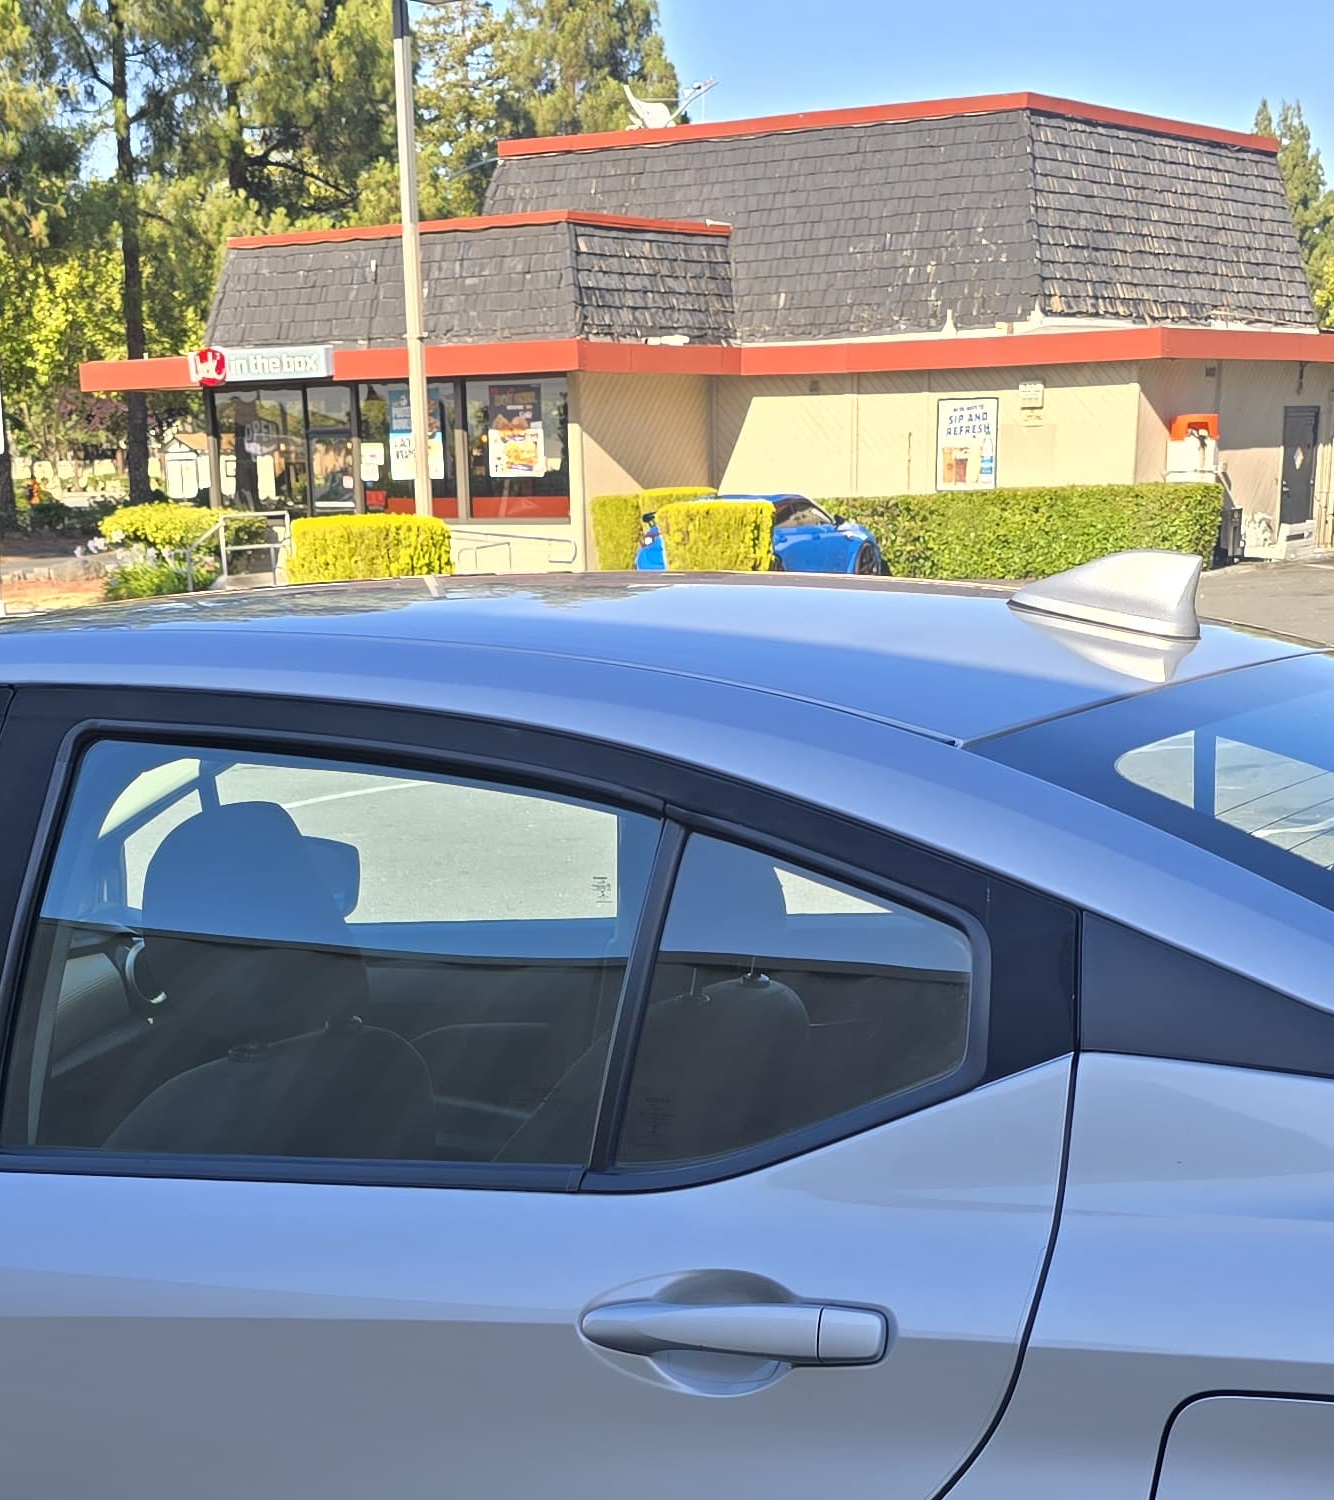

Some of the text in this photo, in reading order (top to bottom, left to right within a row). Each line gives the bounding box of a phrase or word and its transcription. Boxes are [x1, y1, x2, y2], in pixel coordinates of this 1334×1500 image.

[229, 356, 248, 375] in
[249, 354, 281, 374] the
[282, 354, 317, 373] box
[949, 412, 988, 424] SIP AND
[946, 423, 990, 436] REFRESH
